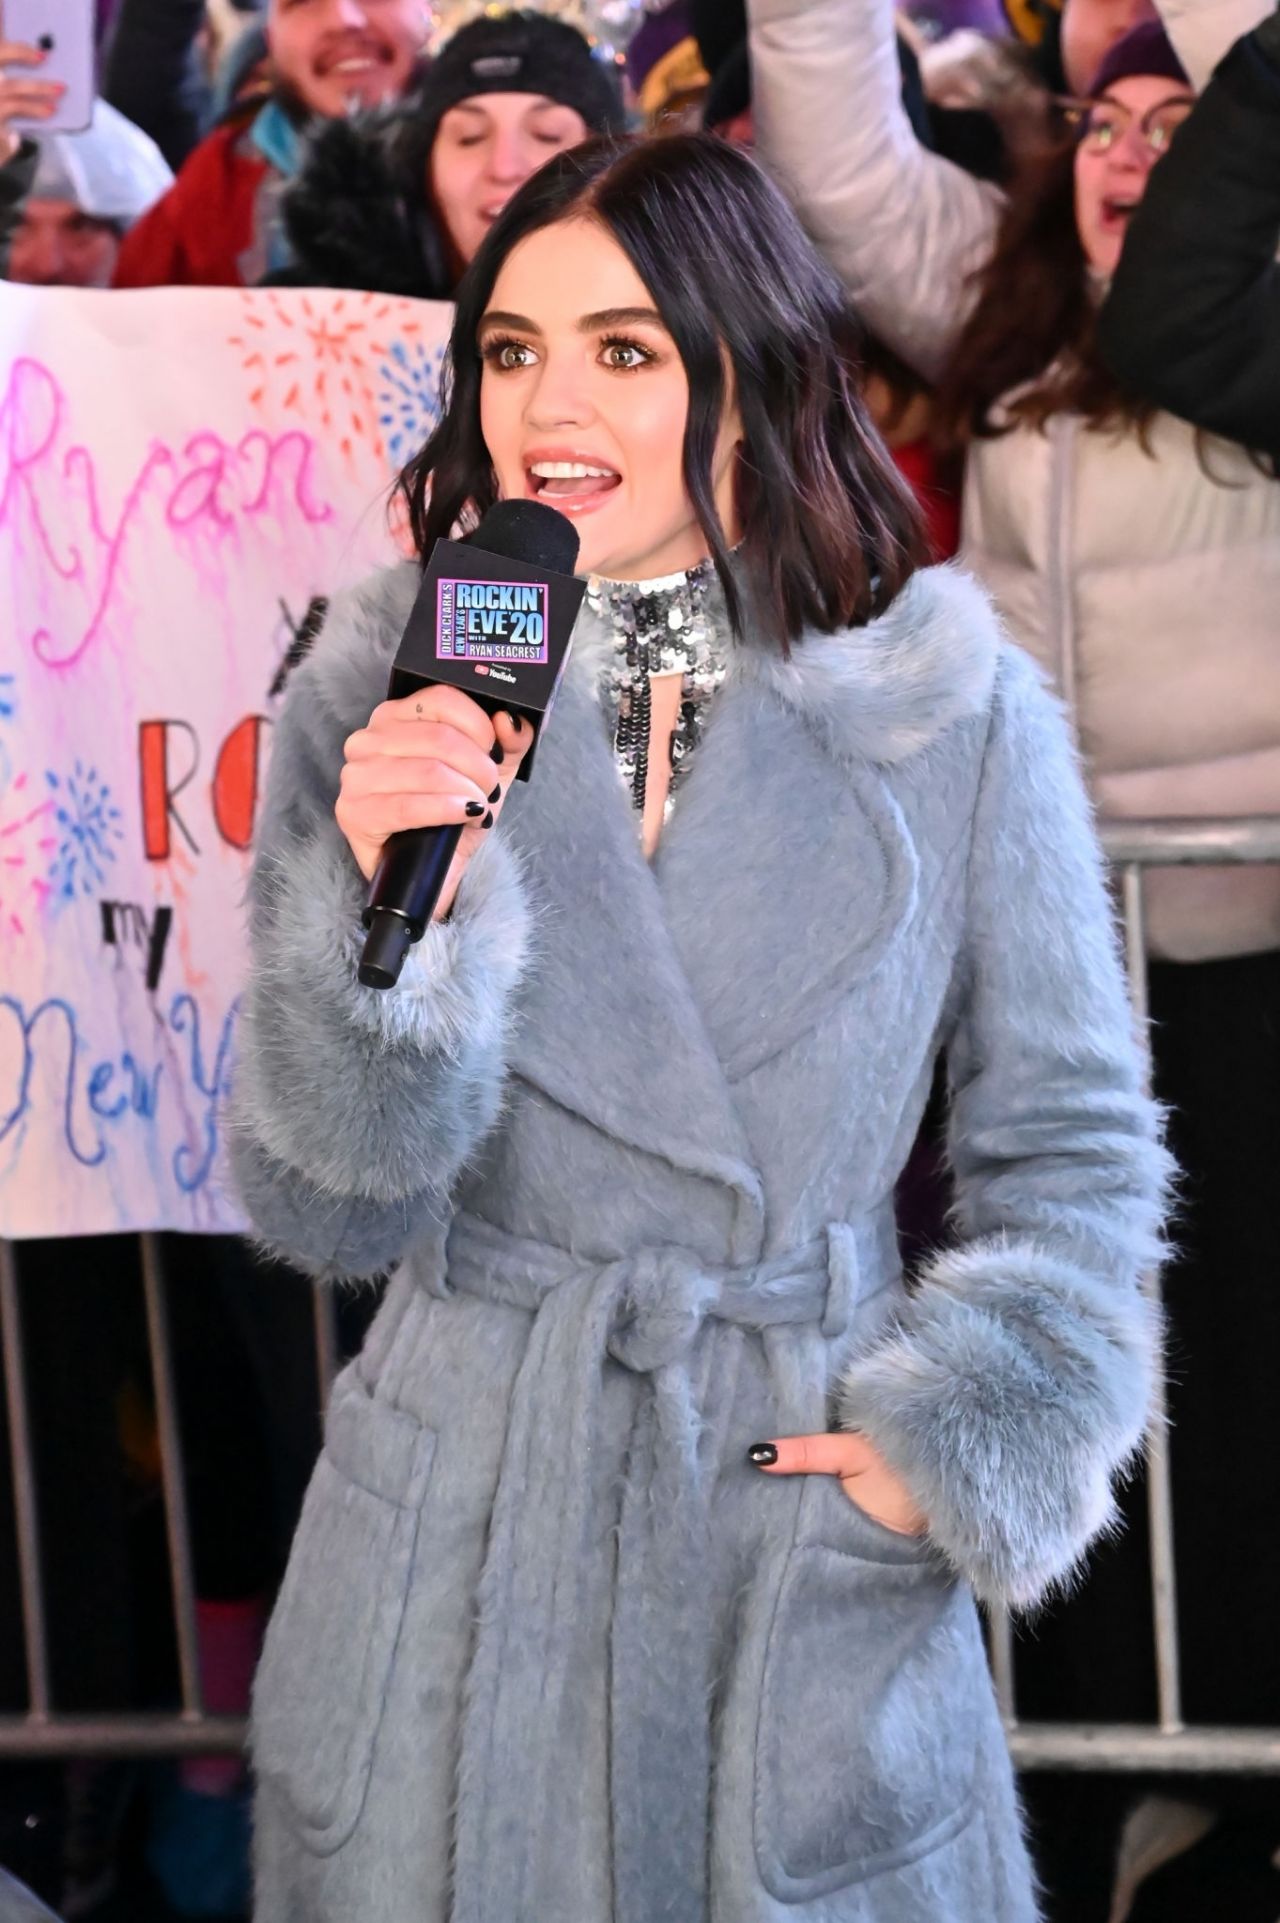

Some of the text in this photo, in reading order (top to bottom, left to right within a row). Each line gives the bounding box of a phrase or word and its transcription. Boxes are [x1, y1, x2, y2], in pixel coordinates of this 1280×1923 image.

[0, 356, 333, 668] Ryan
[442, 629, 453, 654] DICK
[455, 636, 466, 654] NEW
[469, 644, 541, 659] RYAN SEACREST
[489, 668, 517, 684] YouTube
